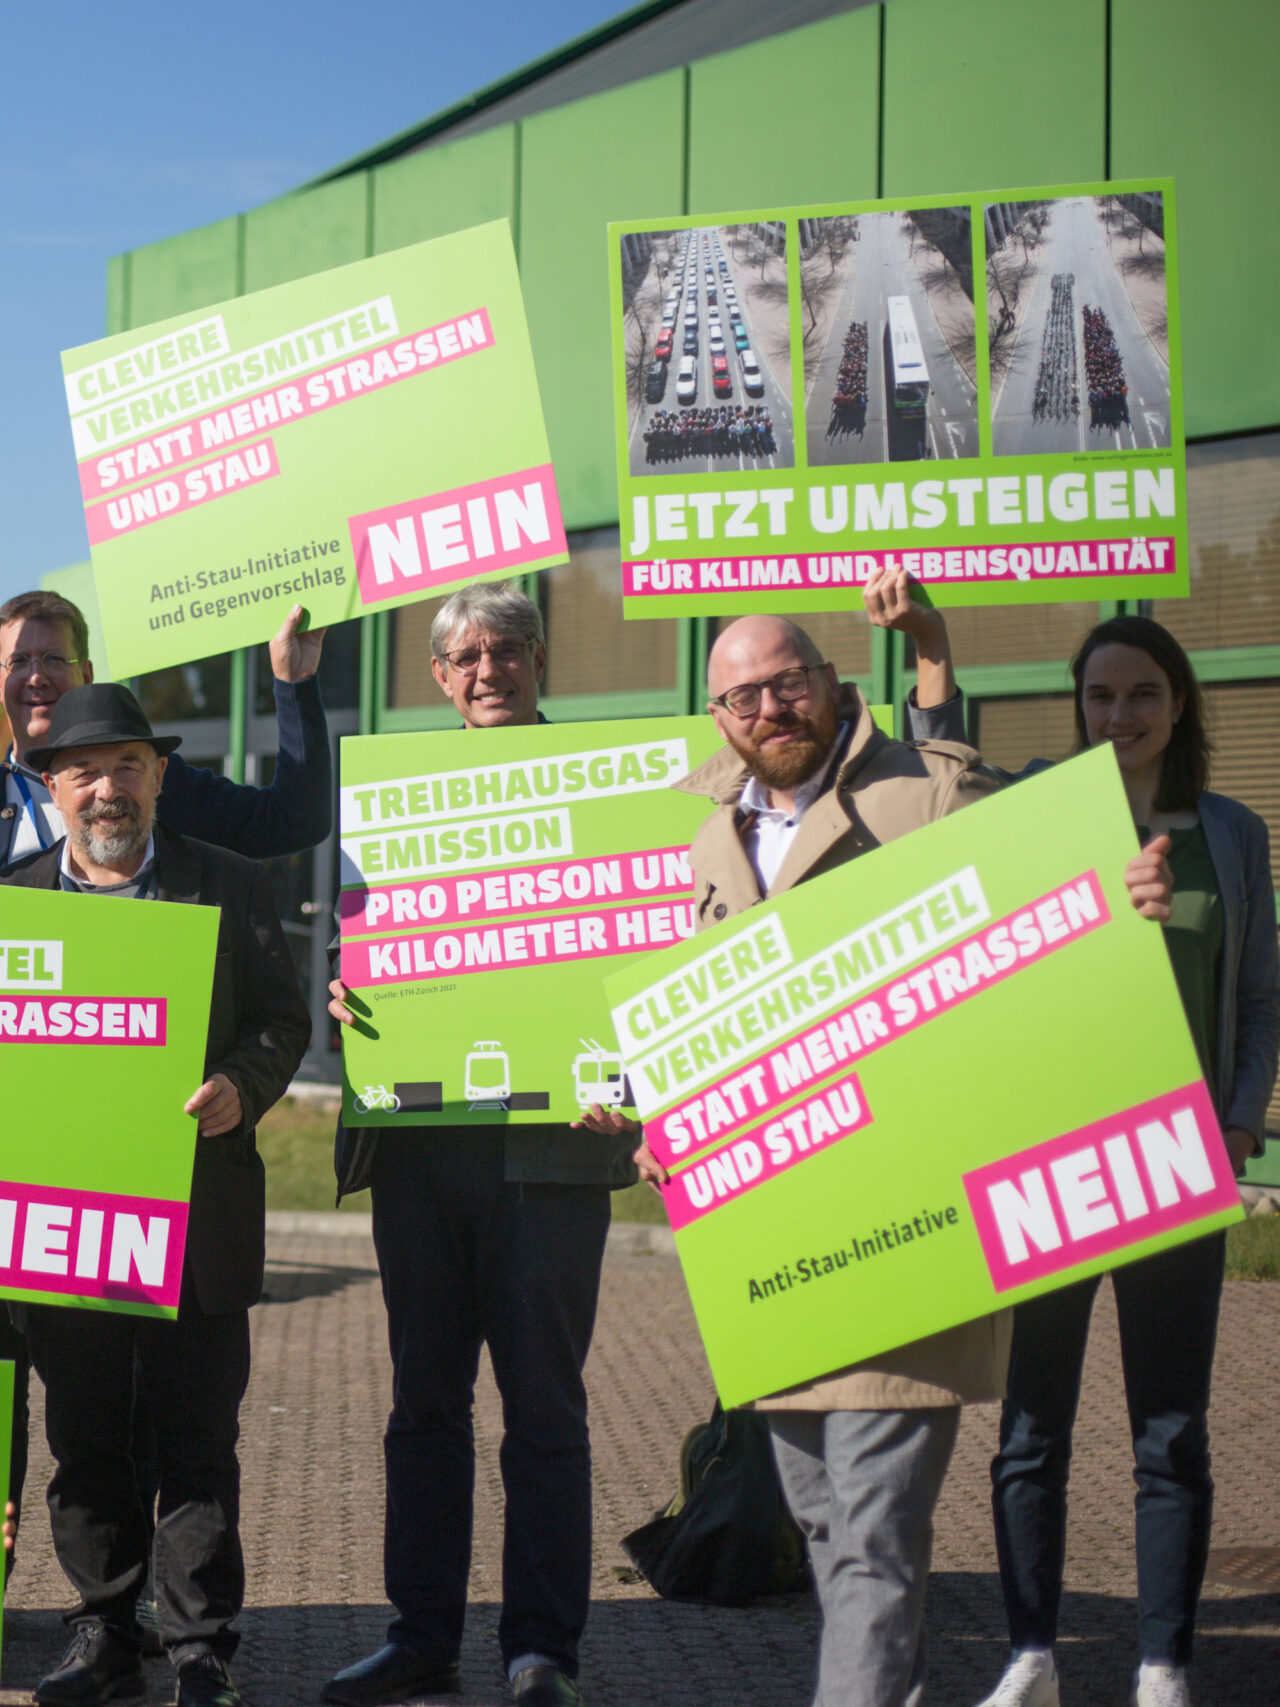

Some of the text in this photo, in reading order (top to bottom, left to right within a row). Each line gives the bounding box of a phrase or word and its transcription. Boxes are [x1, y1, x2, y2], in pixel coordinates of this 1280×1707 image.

[78, 323, 220, 399] CLEVERE
[86, 307, 390, 443] VERKEHRSMITTEL
[97, 314, 487, 488] STATT MEHR STRASSEN
[107, 444, 272, 530] UND STAU
[630, 468, 1175, 555] JETZT UMSTEIGEN
[150, 538, 341, 602] Anti-Stau-Initiative
[368, 482, 550, 585] NEIN
[633, 559, 693, 590] FÜR
[700, 556, 803, 587] KLIMA
[808, 555, 877, 583] UND
[149, 565, 346, 631] und Gegenvorschlag
[354, 748, 679, 822] TREIBHAUSGAS-
[360, 816, 562, 874] EMISSION
[364, 850, 693, 927] PRO PERSON UN
[368, 903, 695, 978] KILOMETER HEU
[627, 925, 782, 1041] CLEVERE
[400, 989, 415, 997] ETH
[440, 984, 456, 992] 2021
[643, 879, 979, 1096] VERKEHRSMITTEL
[664, 880, 1101, 1155] STATT MEHR STRASSEN
[682, 1084, 862, 1209] UND STAU
[987, 1107, 1216, 1266] NEIN
[748, 1203, 959, 1303] Anti-Stau-Initiative
